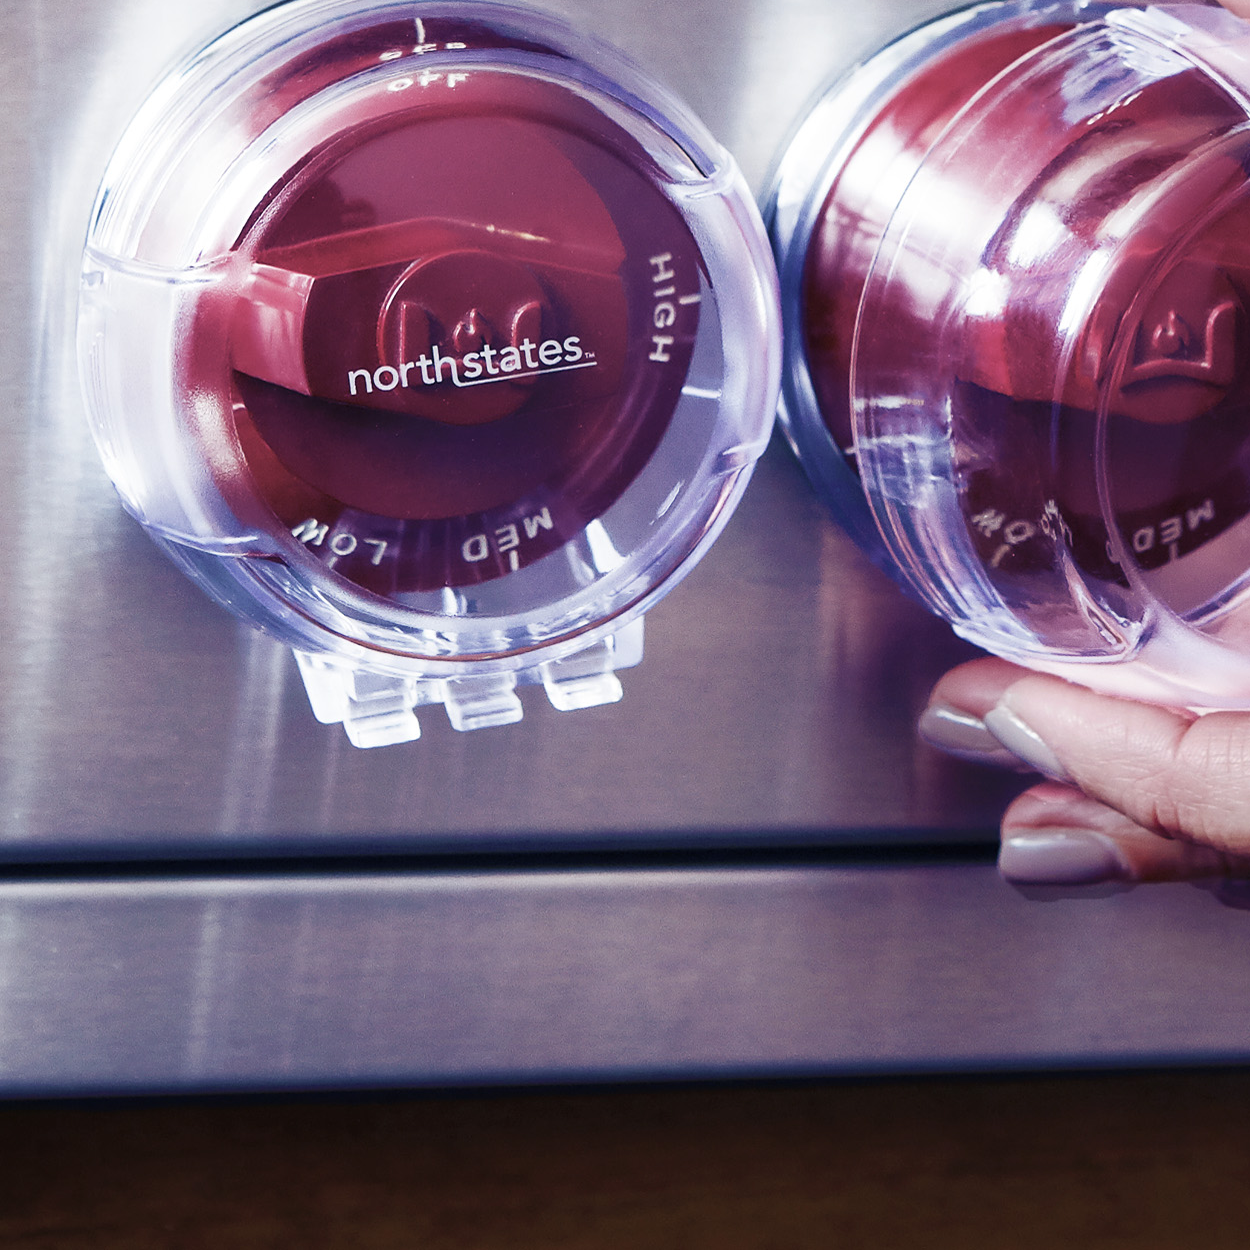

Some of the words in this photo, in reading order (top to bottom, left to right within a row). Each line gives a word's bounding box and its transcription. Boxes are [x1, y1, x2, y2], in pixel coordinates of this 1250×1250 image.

[648, 252, 676, 362] HIGH
[291, 518, 388, 565] LOW
[462, 507, 554, 562] MED
